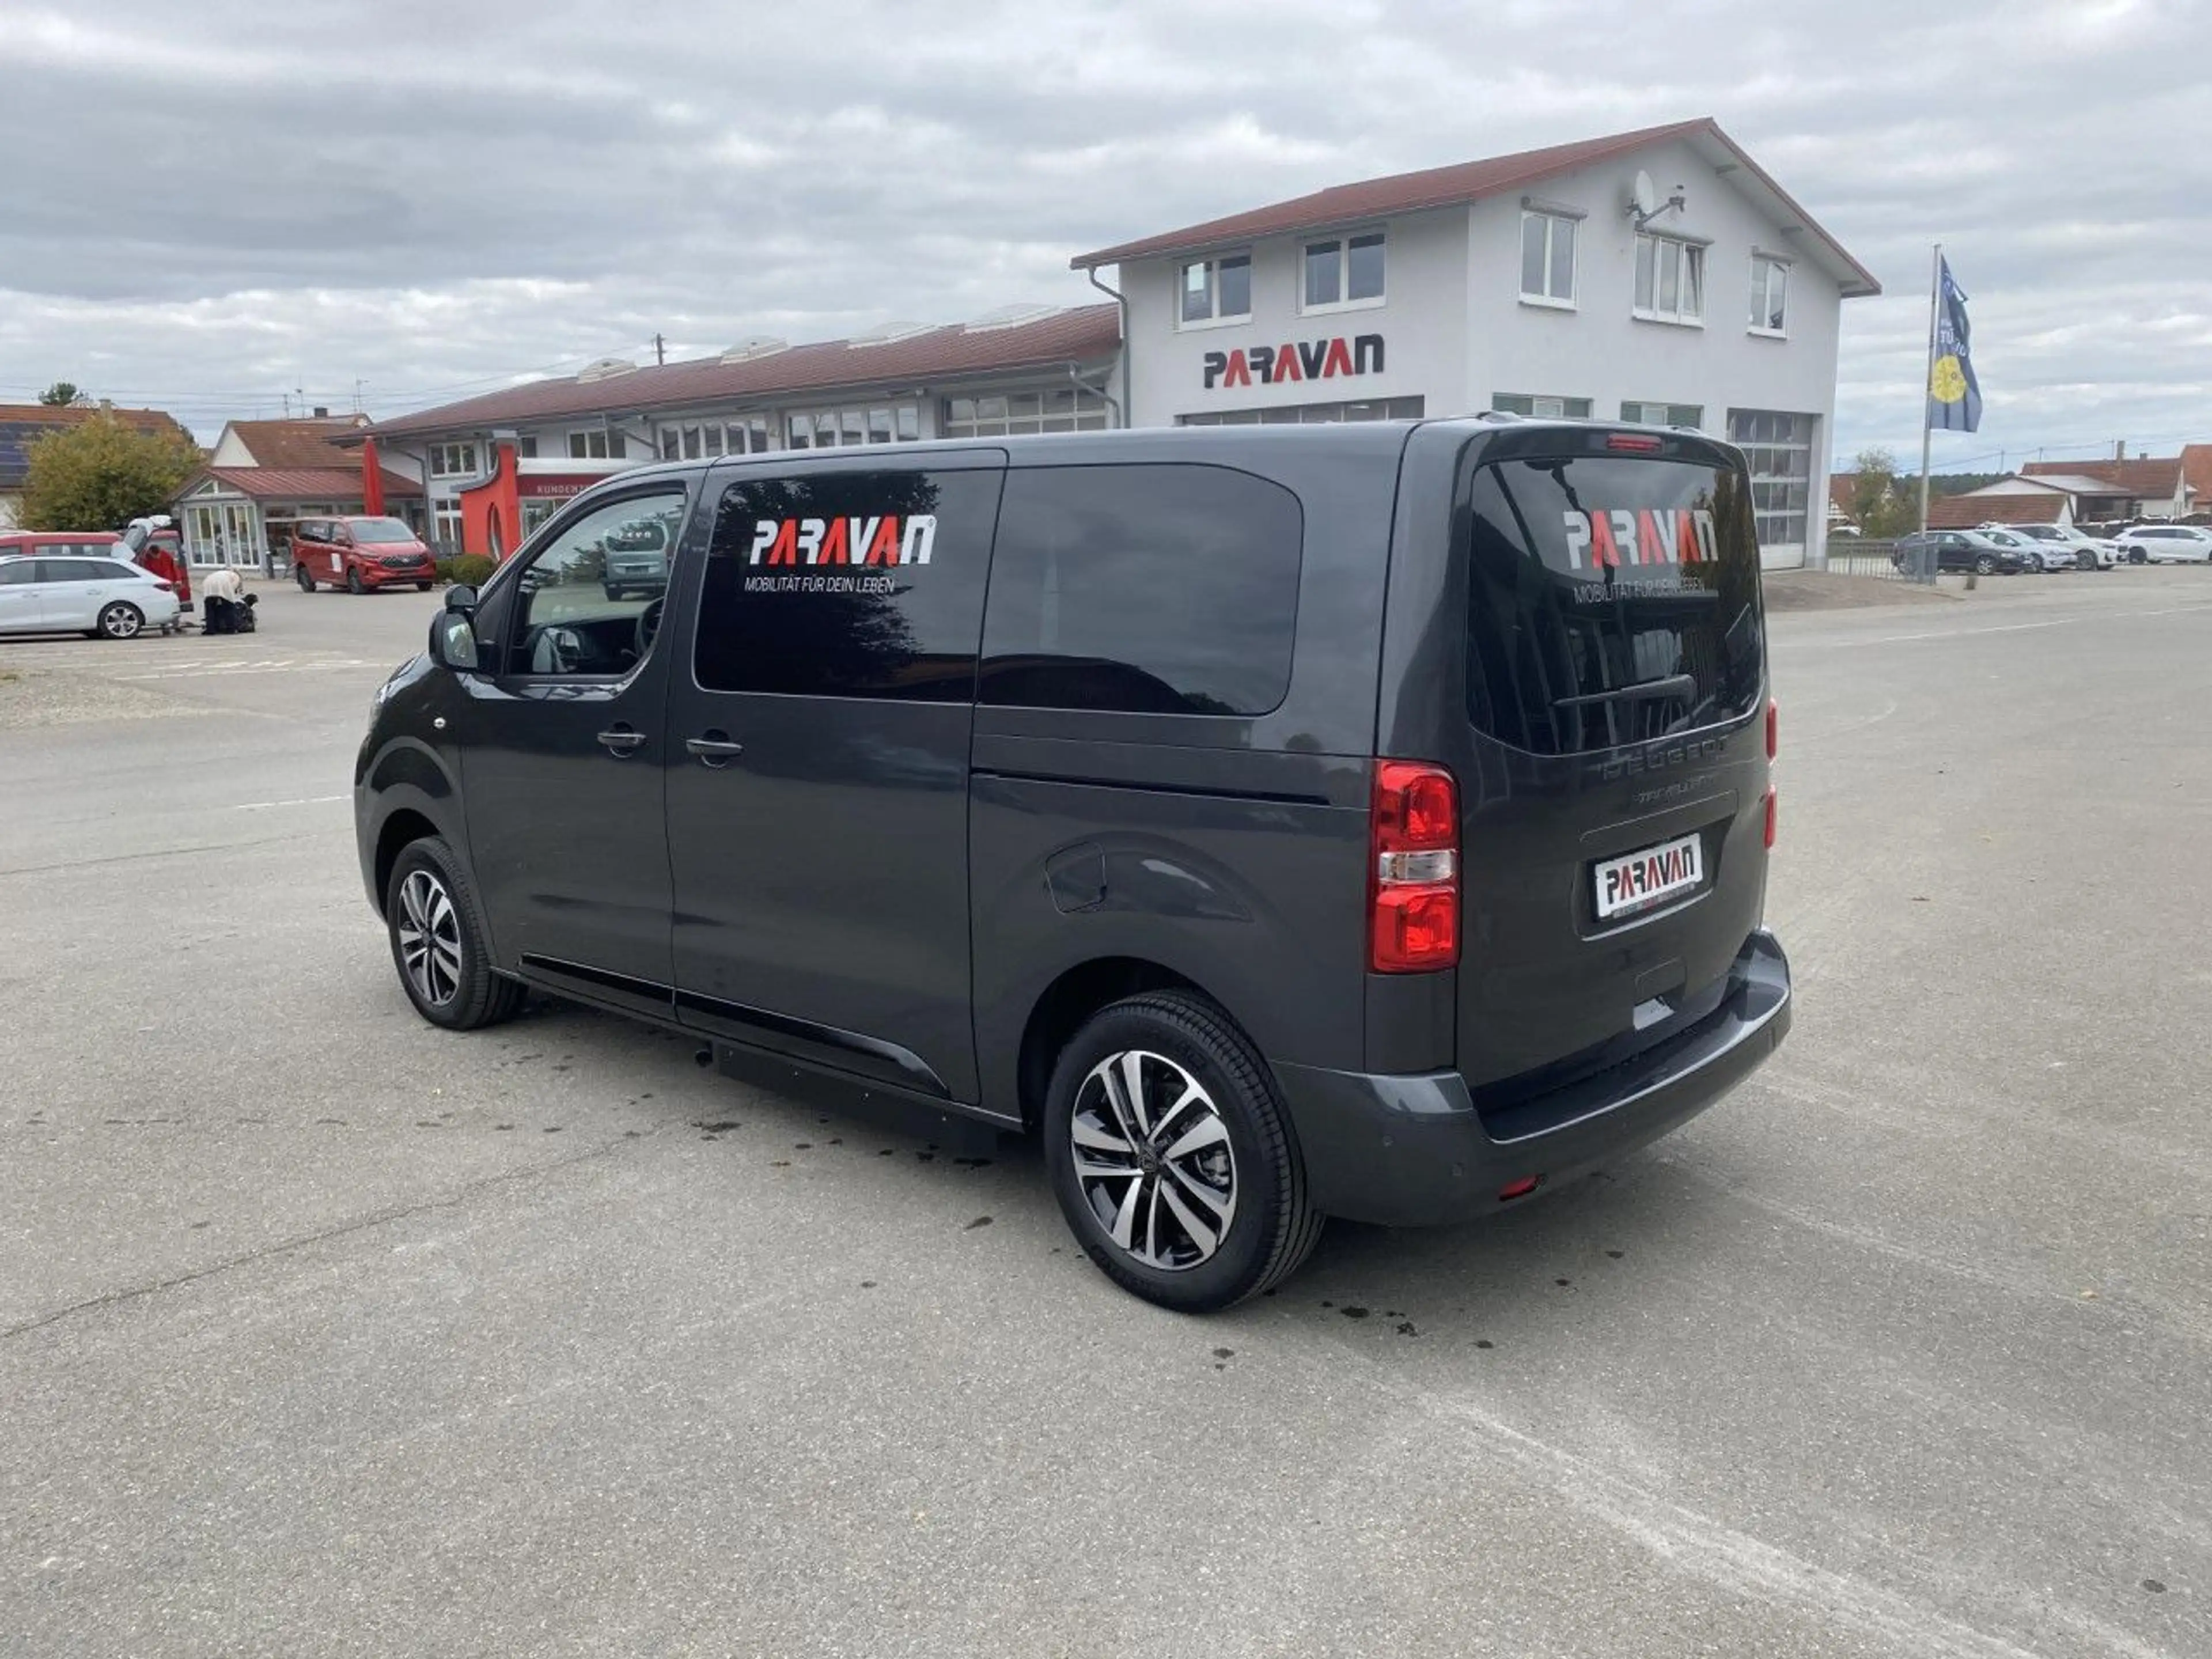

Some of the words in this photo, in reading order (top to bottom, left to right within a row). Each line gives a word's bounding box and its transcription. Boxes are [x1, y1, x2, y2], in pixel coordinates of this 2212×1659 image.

[1204, 334, 1385, 388] PARAVAN
[749, 513, 938, 567] PARAVAN
[1562, 509, 1719, 569] PARAVAN
[744, 574, 801, 592] MOBILITÄT
[802, 574, 825, 593] FÜR
[826, 576, 854, 593] DEIN
[855, 577, 895, 593] LEBEN
[1605, 844, 1695, 905] PARAVAN
